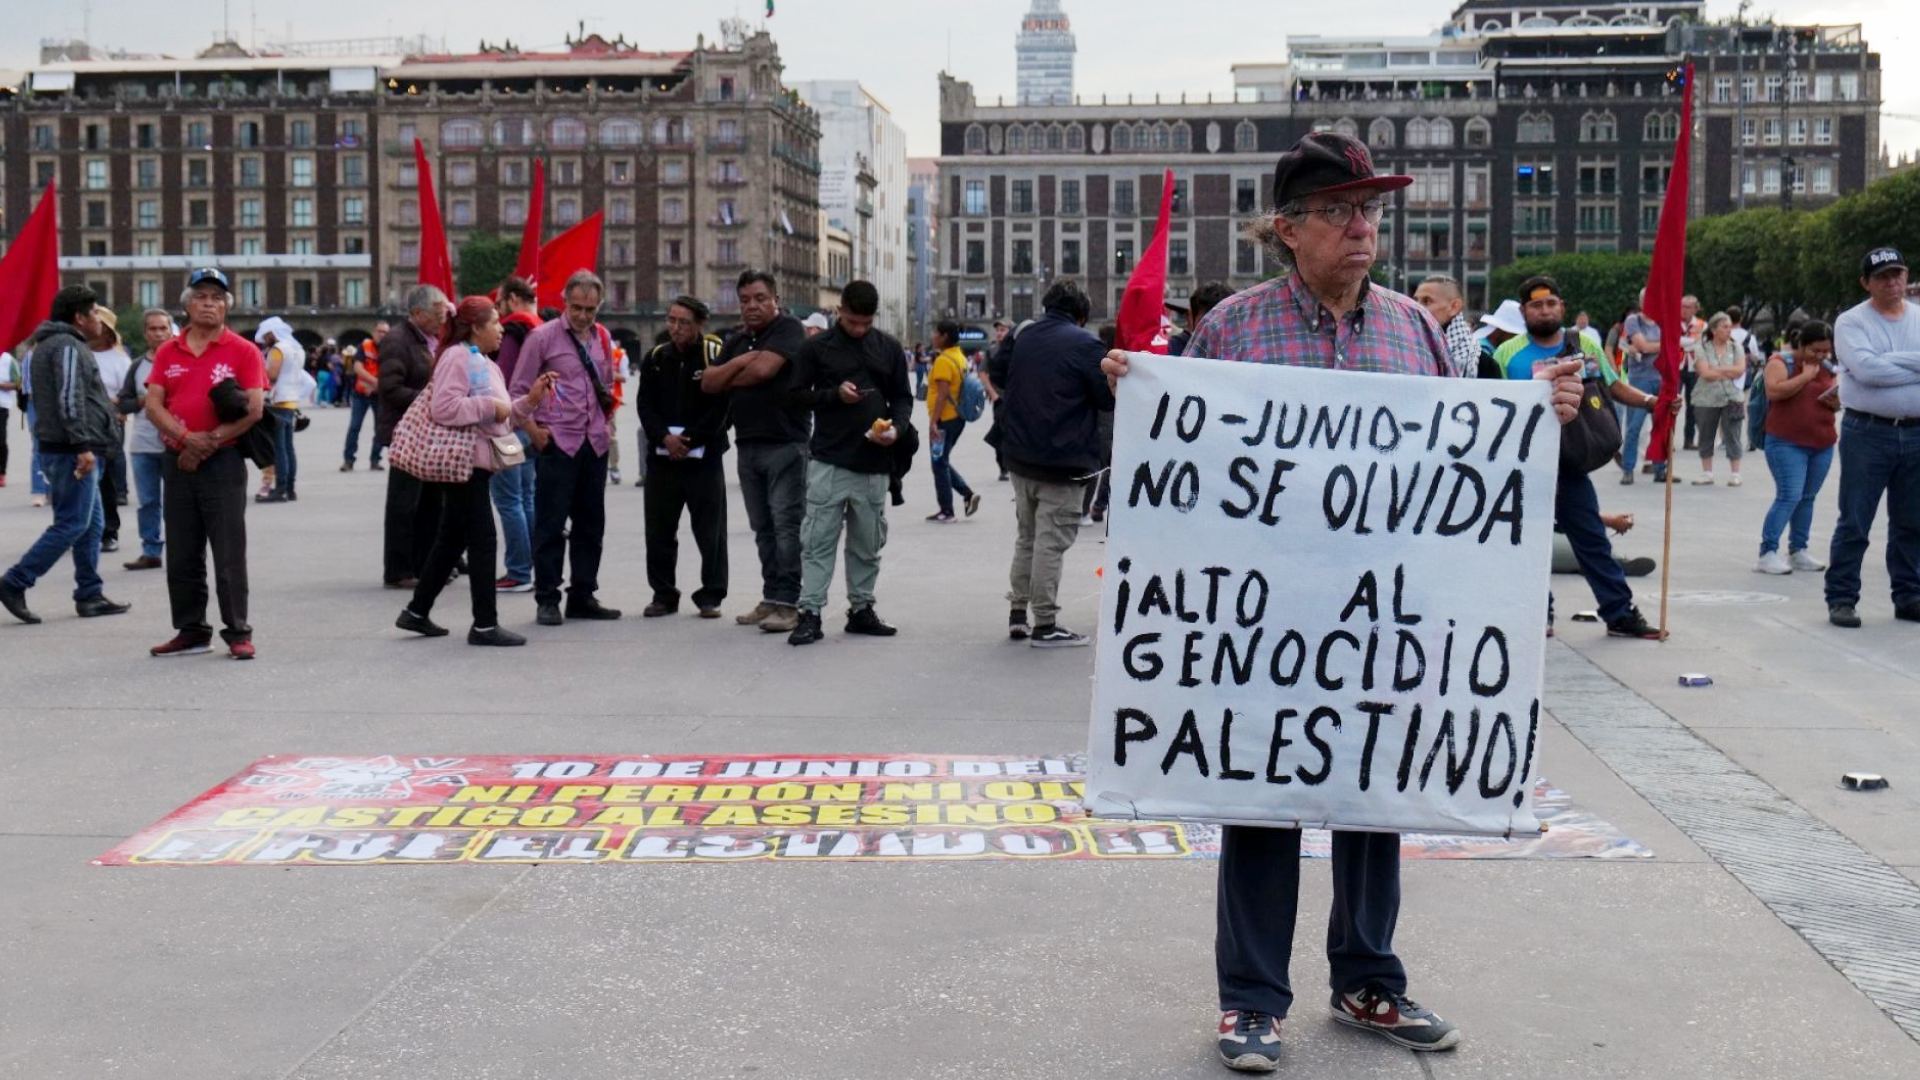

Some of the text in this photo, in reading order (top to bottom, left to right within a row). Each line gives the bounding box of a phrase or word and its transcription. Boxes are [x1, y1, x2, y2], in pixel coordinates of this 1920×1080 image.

[1128, 456, 1524, 545] NO SE OLVIDA
[1115, 557, 1422, 636] ¡ALTO AL
[511, 760, 1082, 779] 10 DE JUNIO DEL
[1114, 698, 1539, 809] PALESTINO!
[214, 803, 1058, 828] CASTIGO AL ASESINO
[450, 785, 541, 803] NI
[547, 781, 866, 803] PERDÓN
[885, 783, 966, 802] NI
